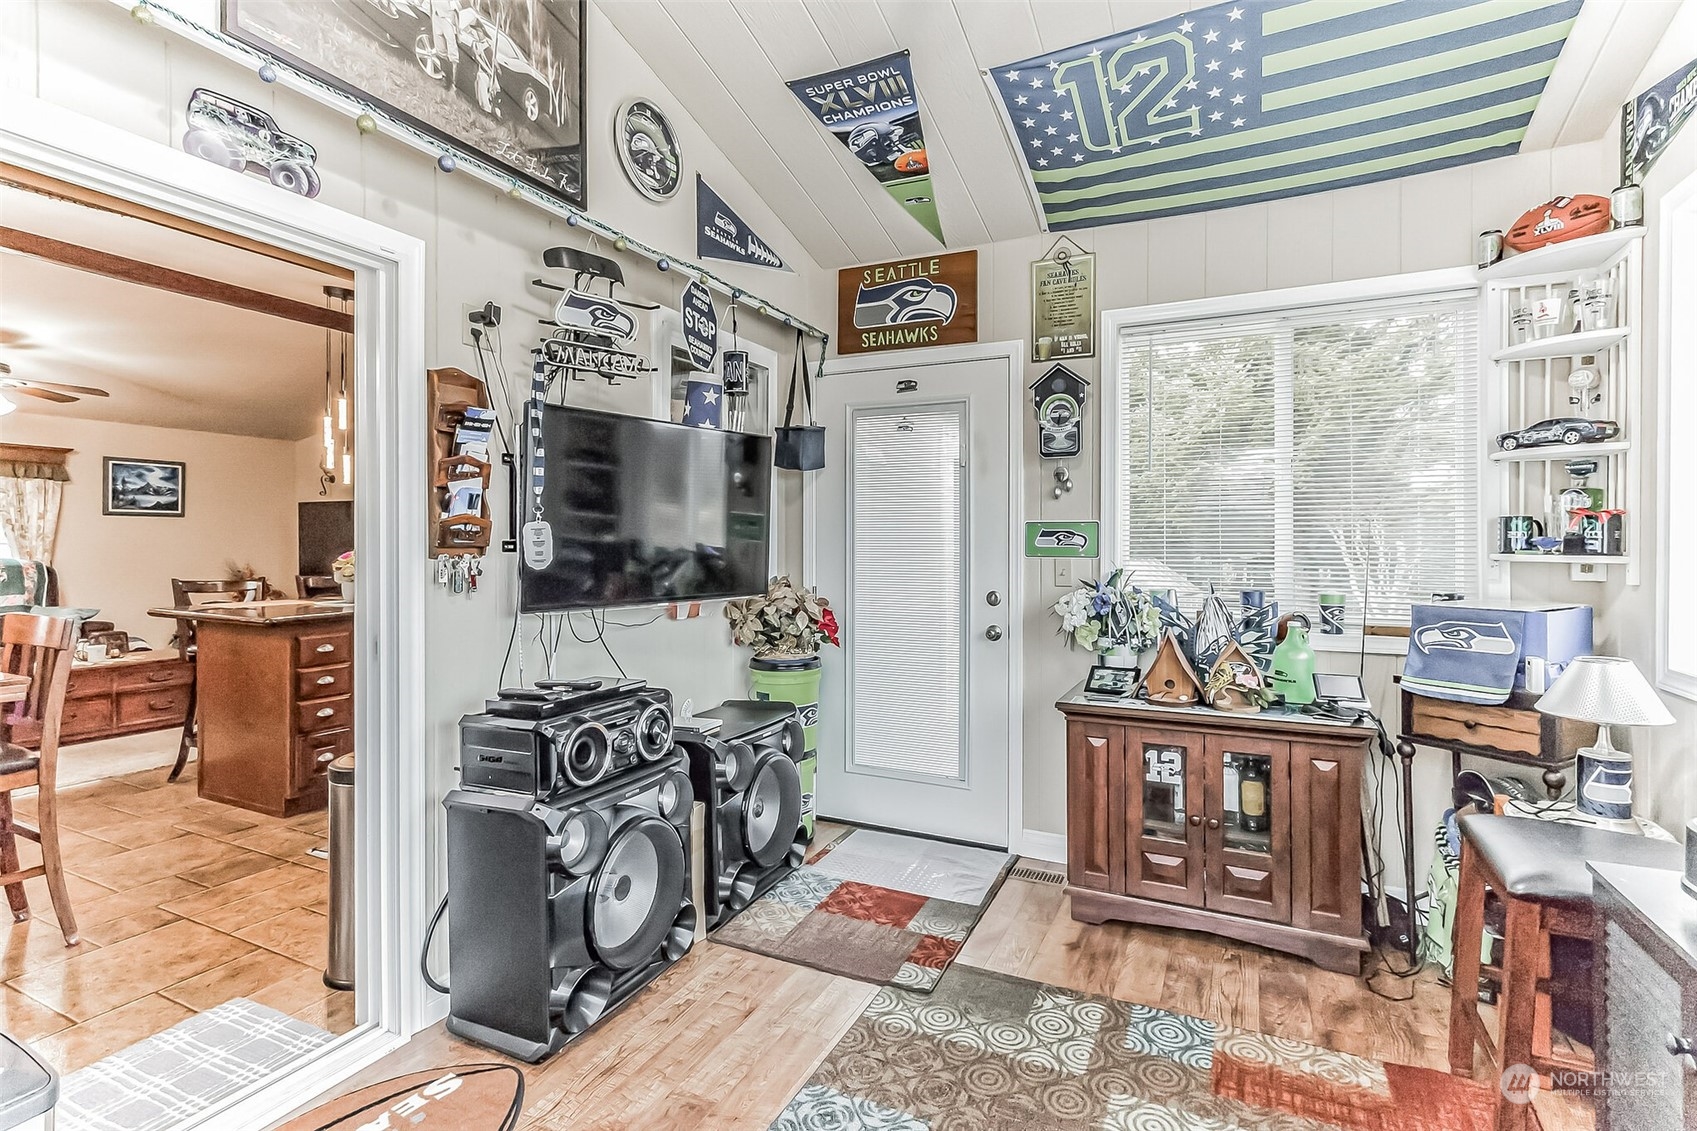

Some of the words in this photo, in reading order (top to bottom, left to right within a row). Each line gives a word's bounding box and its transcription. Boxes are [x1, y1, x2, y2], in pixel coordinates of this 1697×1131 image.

[806, 78, 853, 97] SUPER
[858, 66, 900, 85] BOWL
[811, 75, 910, 114] XLVIII
[1053, 32, 1201, 152] 12
[823, 96, 914, 124] CHAMPIONS
[704, 226, 746, 256] SEAHAWKS
[864, 258, 940, 284] SEATTLE
[1047, 270, 1080, 279] SEAHAKS
[685, 307, 716, 340] STOP
[861, 325, 938, 348] SEAHAWKS
[1145, 749, 1182, 785] 12
